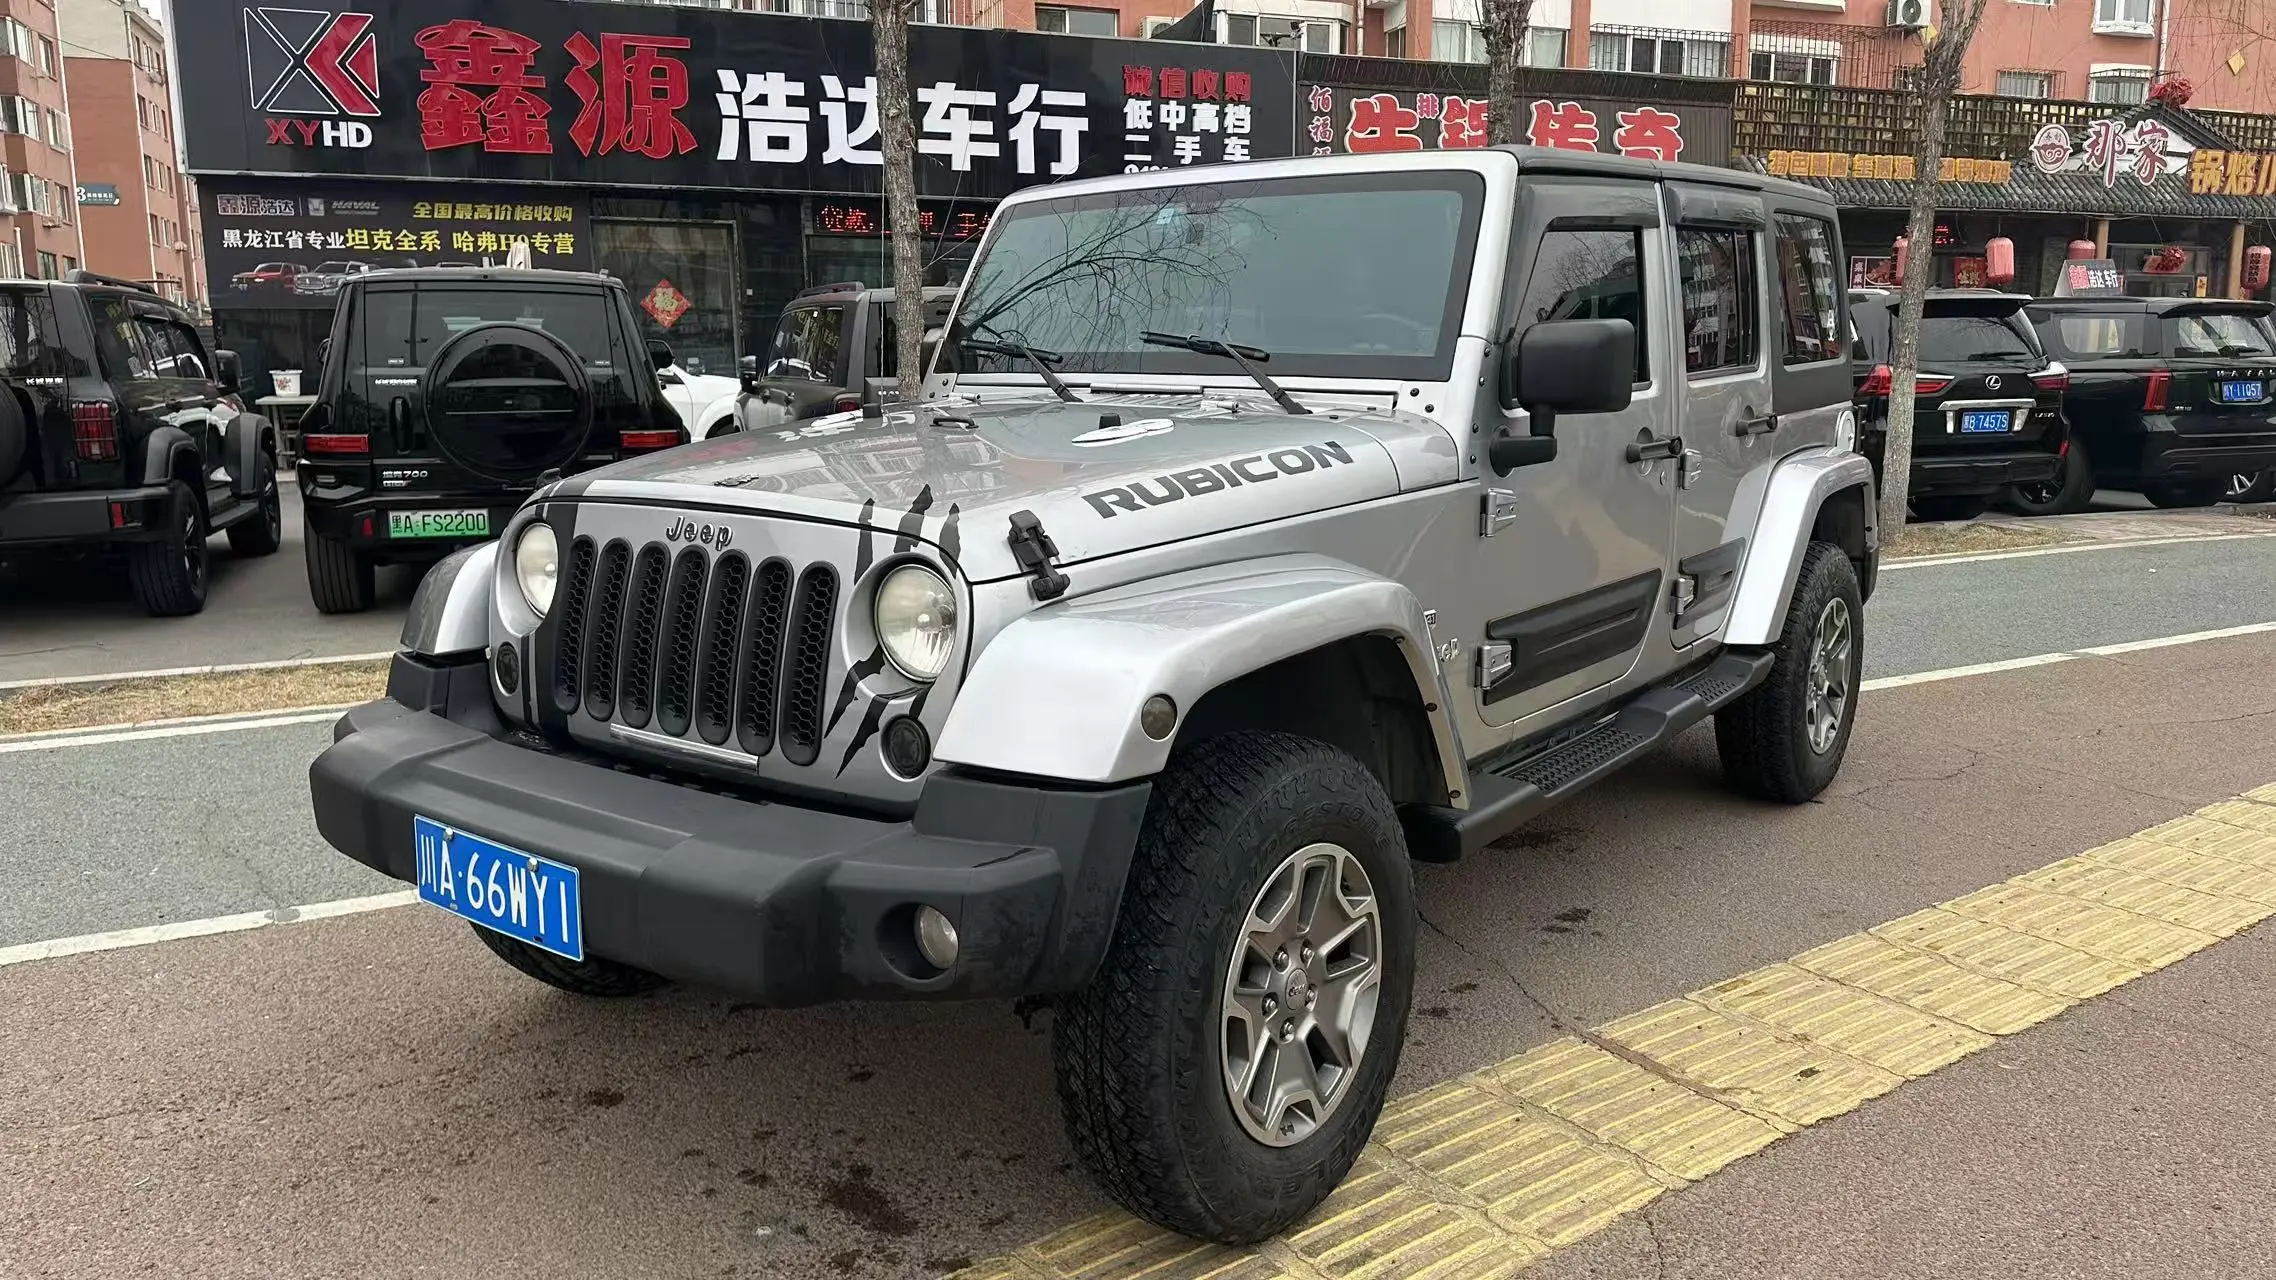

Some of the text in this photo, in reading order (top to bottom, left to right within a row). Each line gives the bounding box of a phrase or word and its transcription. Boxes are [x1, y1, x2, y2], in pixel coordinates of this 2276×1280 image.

[414, 19, 1089, 175] 鑫源 浩达车行
[1123, 64, 1251, 102] 诚信收购
[265, 118, 373, 149] XYHD
[1123, 98, 1251, 134] 低中高档
[1123, 134, 1251, 165] 二手车
[2084, 118, 2169, 188] 那家
[413, 201, 573, 222] 全国最高价格收购
[222, 228, 441, 252] 黑龙江省专业坦克全系
[1082, 440, 1355, 520] RUBICON
[666, 515, 734, 551] Jeep
